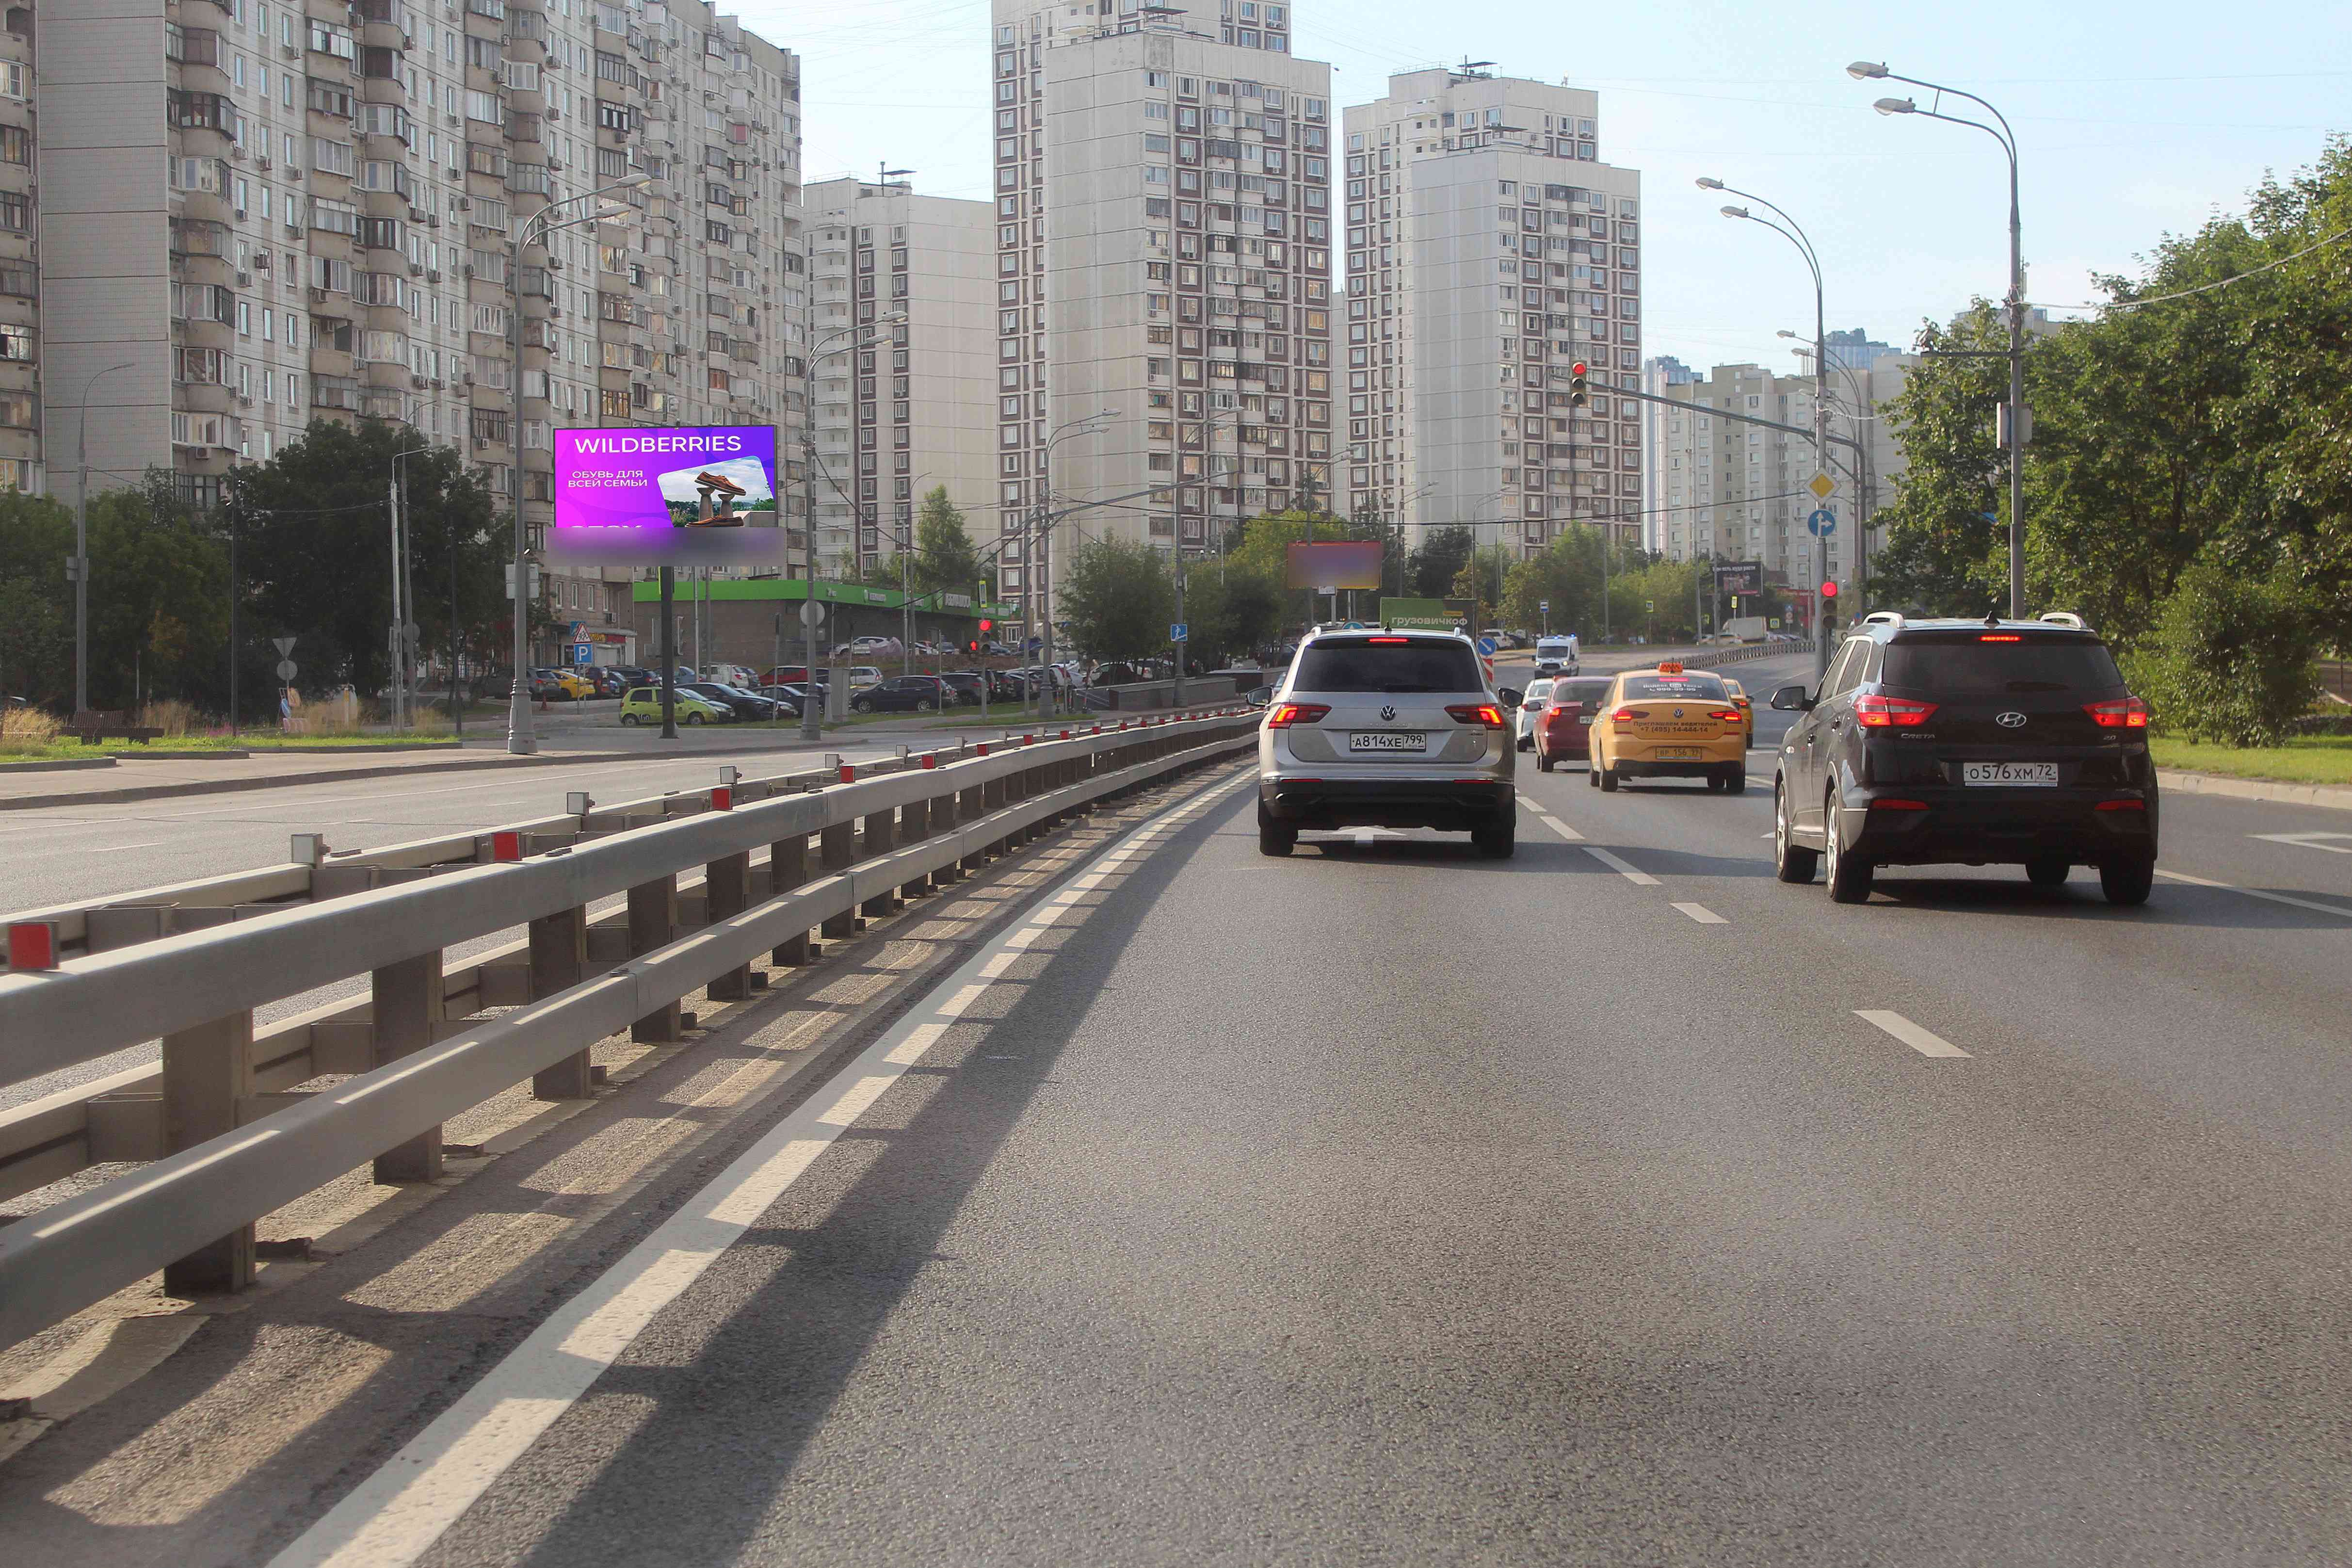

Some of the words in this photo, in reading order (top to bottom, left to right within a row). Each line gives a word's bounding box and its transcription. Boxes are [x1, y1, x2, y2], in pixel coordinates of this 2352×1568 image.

[574, 436, 742, 453] WILDBERRIES
[616, 470, 643, 478] ДЛЯ
[568, 478, 601, 488] ВСЕЙ
[603, 479, 647, 487] СЕМЬИ
[1391, 617, 1468, 626] грузовичкоф
[1404, 735, 1422, 744] 799
[2037, 764, 2052, 776] 72
